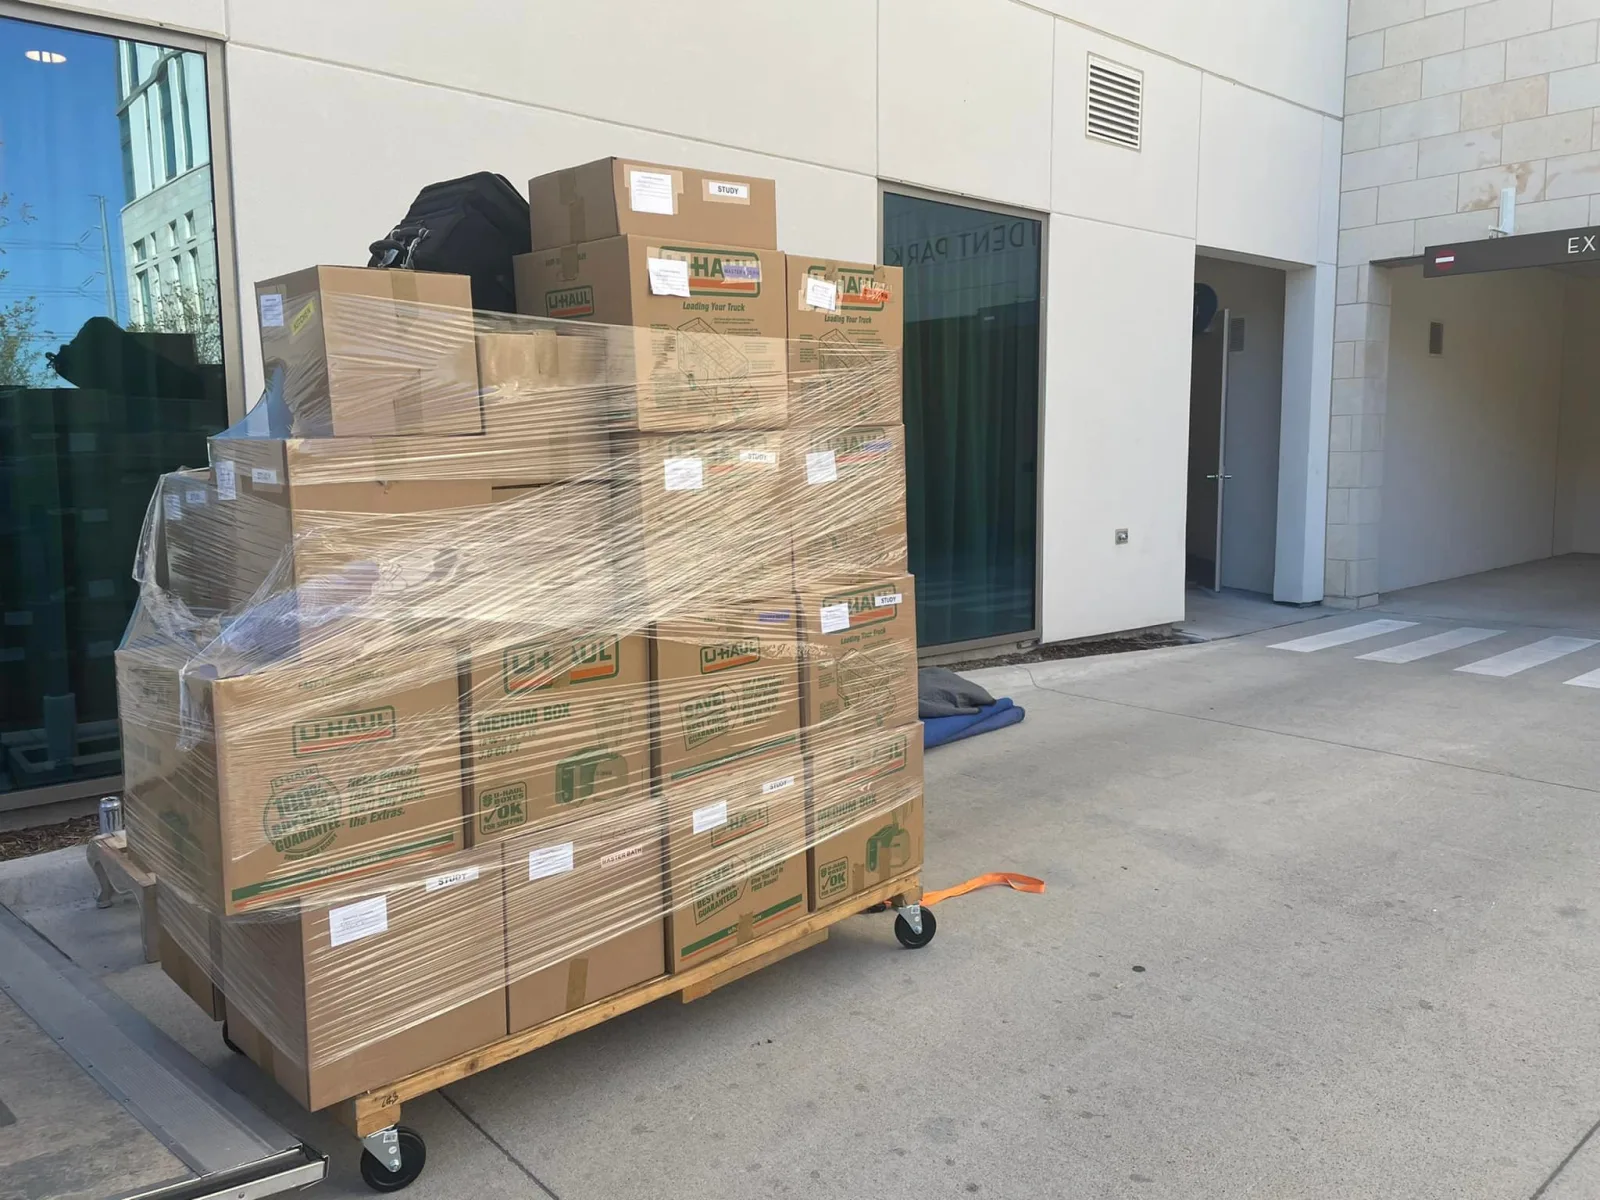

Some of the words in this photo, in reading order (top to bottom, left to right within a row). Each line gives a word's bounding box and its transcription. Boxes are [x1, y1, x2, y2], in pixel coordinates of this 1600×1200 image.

[717, 185, 739, 195] STUDY
[1568, 235, 1596, 254] EX
[548, 291, 590, 309] U-HAUL
[683, 301, 709, 312] Loading
[711, 302, 726, 311] Your
[728, 303, 745, 312] Truck
[824, 314, 845, 324] Loading
[846, 315, 858, 323] Your
[859, 316, 872, 324] Truck
[747, 452, 767, 461] STUDY
[881, 596, 896, 604] STUDY
[497, 803, 523, 819] OK
[438, 873, 467, 886] STUDY
[830, 871, 845, 886] OK
